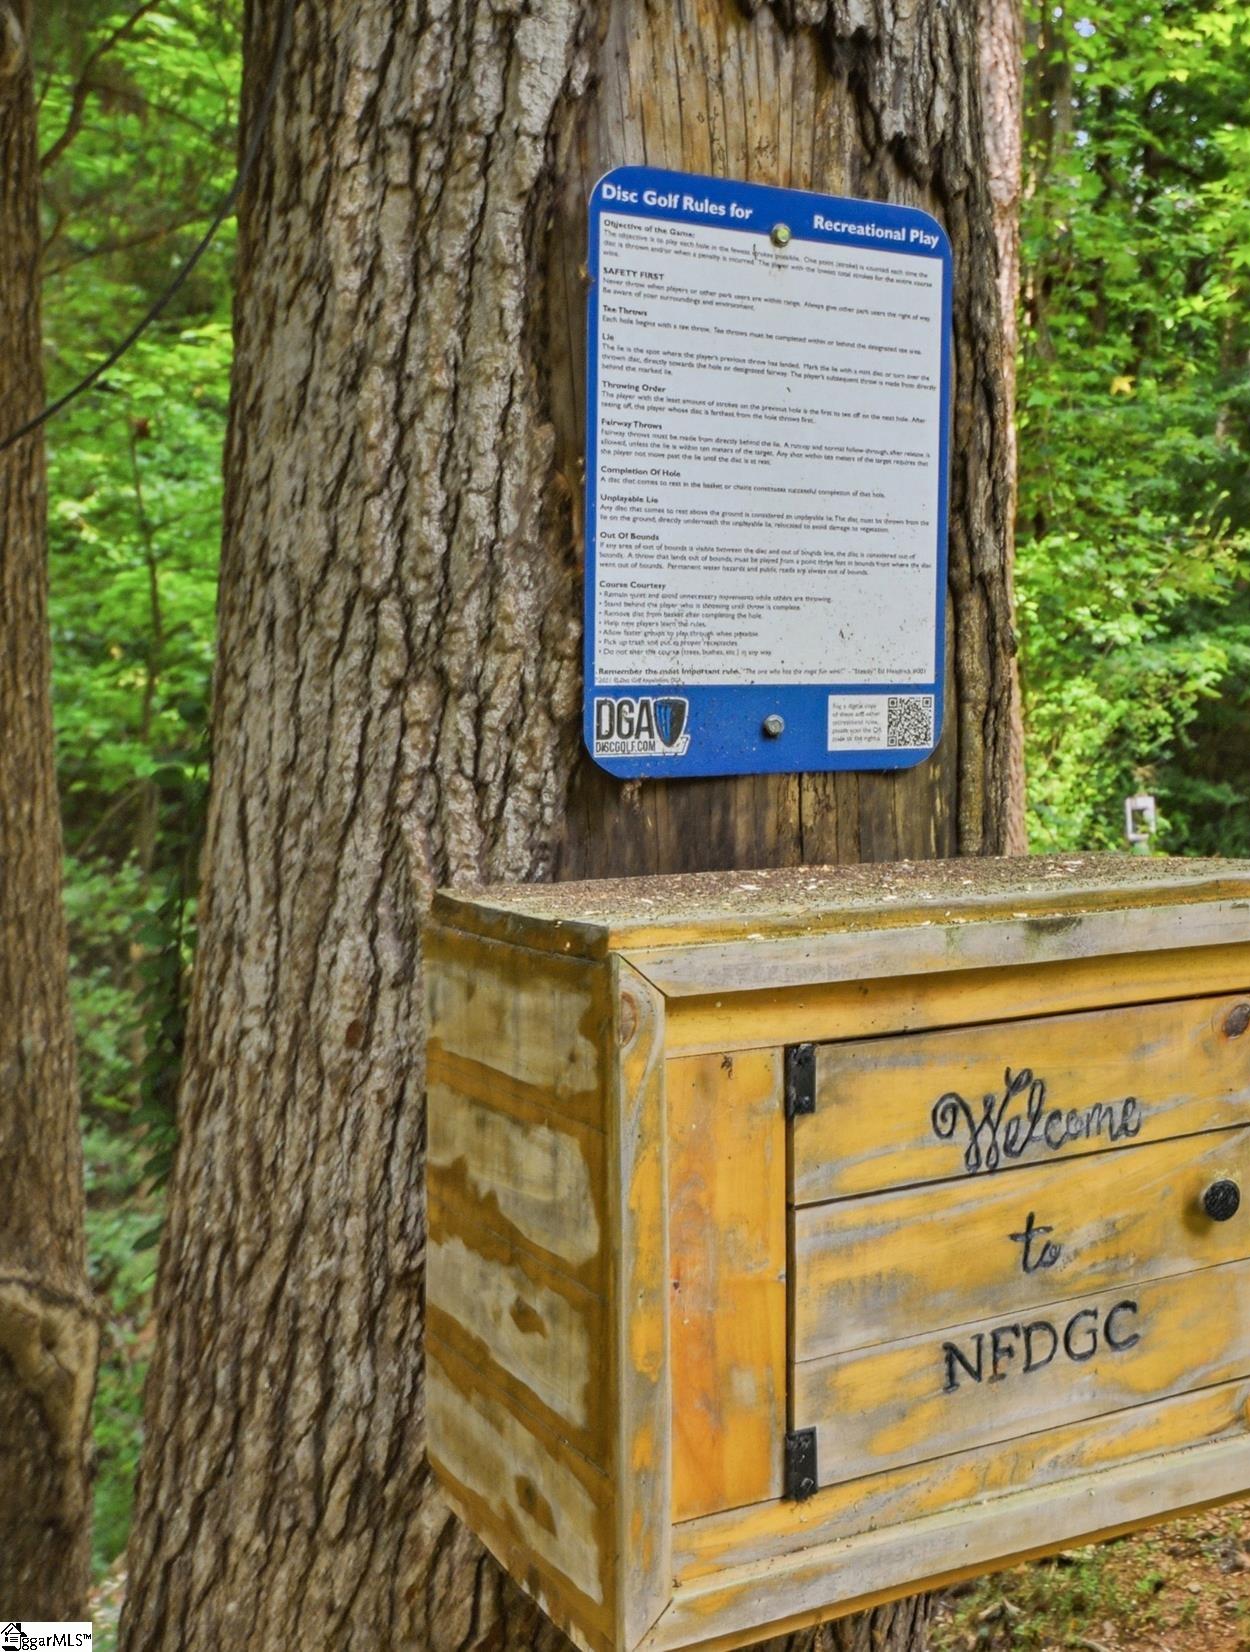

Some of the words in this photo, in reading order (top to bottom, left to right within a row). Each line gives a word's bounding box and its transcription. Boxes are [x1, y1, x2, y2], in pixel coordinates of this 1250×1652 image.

[602, 183, 638, 203] Disc
[643, 190, 679, 210] Golf
[682, 195, 726, 216] Rules
[730, 201, 753, 220] for
[603, 219, 642, 231] Objective
[643, 225, 653, 233] of
[654, 226, 668, 234] the
[669, 228, 695, 238] Game:
[814, 215, 906, 241] Recreational
[909, 229, 940, 249] Play
[603, 267, 638, 277] SAFETY
[639, 271, 664, 280] FIRST
[603, 304, 617, 313] Tee
[618, 306, 648, 316] Throws
[601, 332, 615, 341] Lie
[602, 380, 640, 392] Throwing
[641, 383, 666, 393] Order
[601, 418, 632, 429] Fairway
[633, 420, 662, 430] Throws
[600, 465, 648, 475] Completion
[649, 468, 661, 476] Of
[661, 469, 681, 477] Hole
[600, 494, 644, 503] Unplayable
[645, 496, 659, 504] Lie
[599, 531, 616, 539] Out
[617, 531, 629, 540] Of
[630, 532, 659, 541] Bounds
[599, 580, 628, 588] Course
[629, 581, 666, 590] Courtesy
[598, 667, 642, 675] Remember
[658, 667, 680, 675] most
[681, 667, 720, 675] important
[596, 699, 655, 740] DGA
[596, 740, 656, 753] DISCGOLF.COM
[932, 1066, 1142, 1175] Welcome
[1008, 1211, 1062, 1274] to
[941, 1300, 1142, 1394] NFDGC
